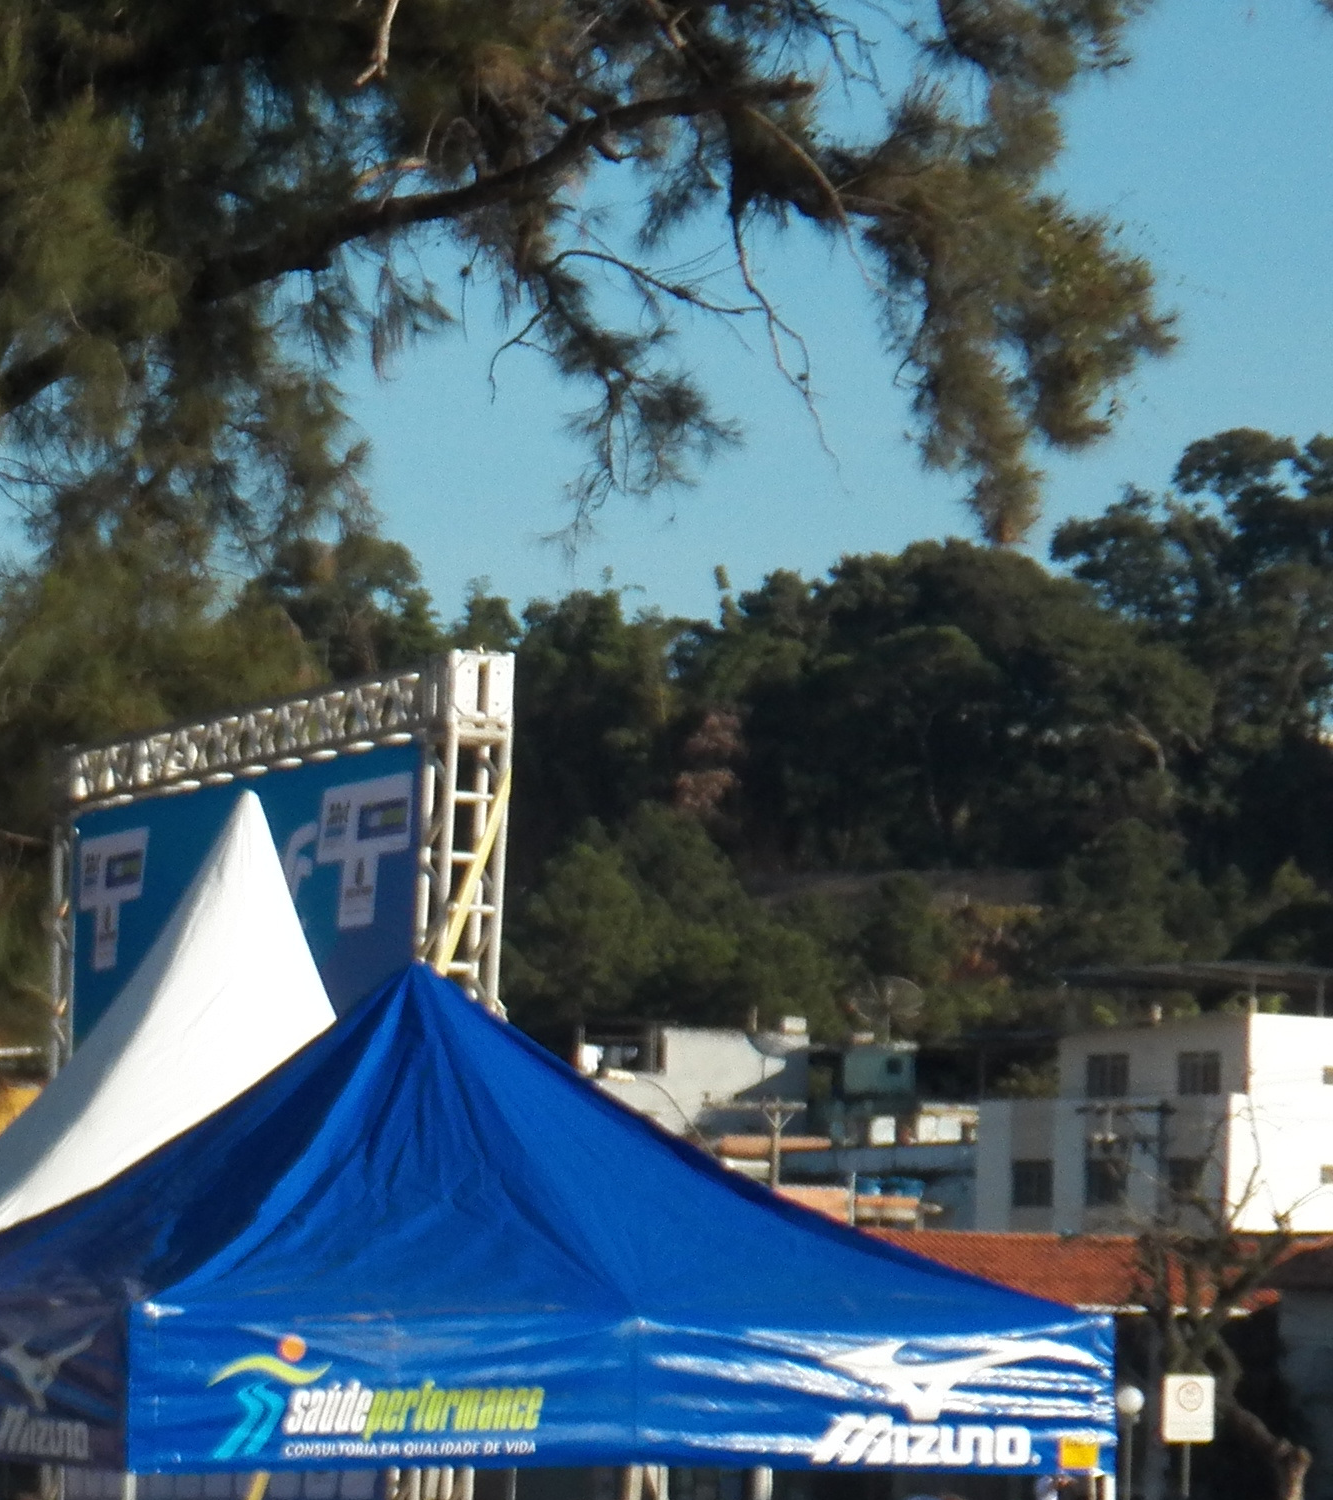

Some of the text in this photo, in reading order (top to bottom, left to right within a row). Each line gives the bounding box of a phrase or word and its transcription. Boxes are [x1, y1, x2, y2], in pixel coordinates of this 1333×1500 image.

[284, 1378, 545, 1441] saúdeperformance
[284, 1440, 536, 1458] CONSULTORIA EM QUALIDADE DE VIDA
